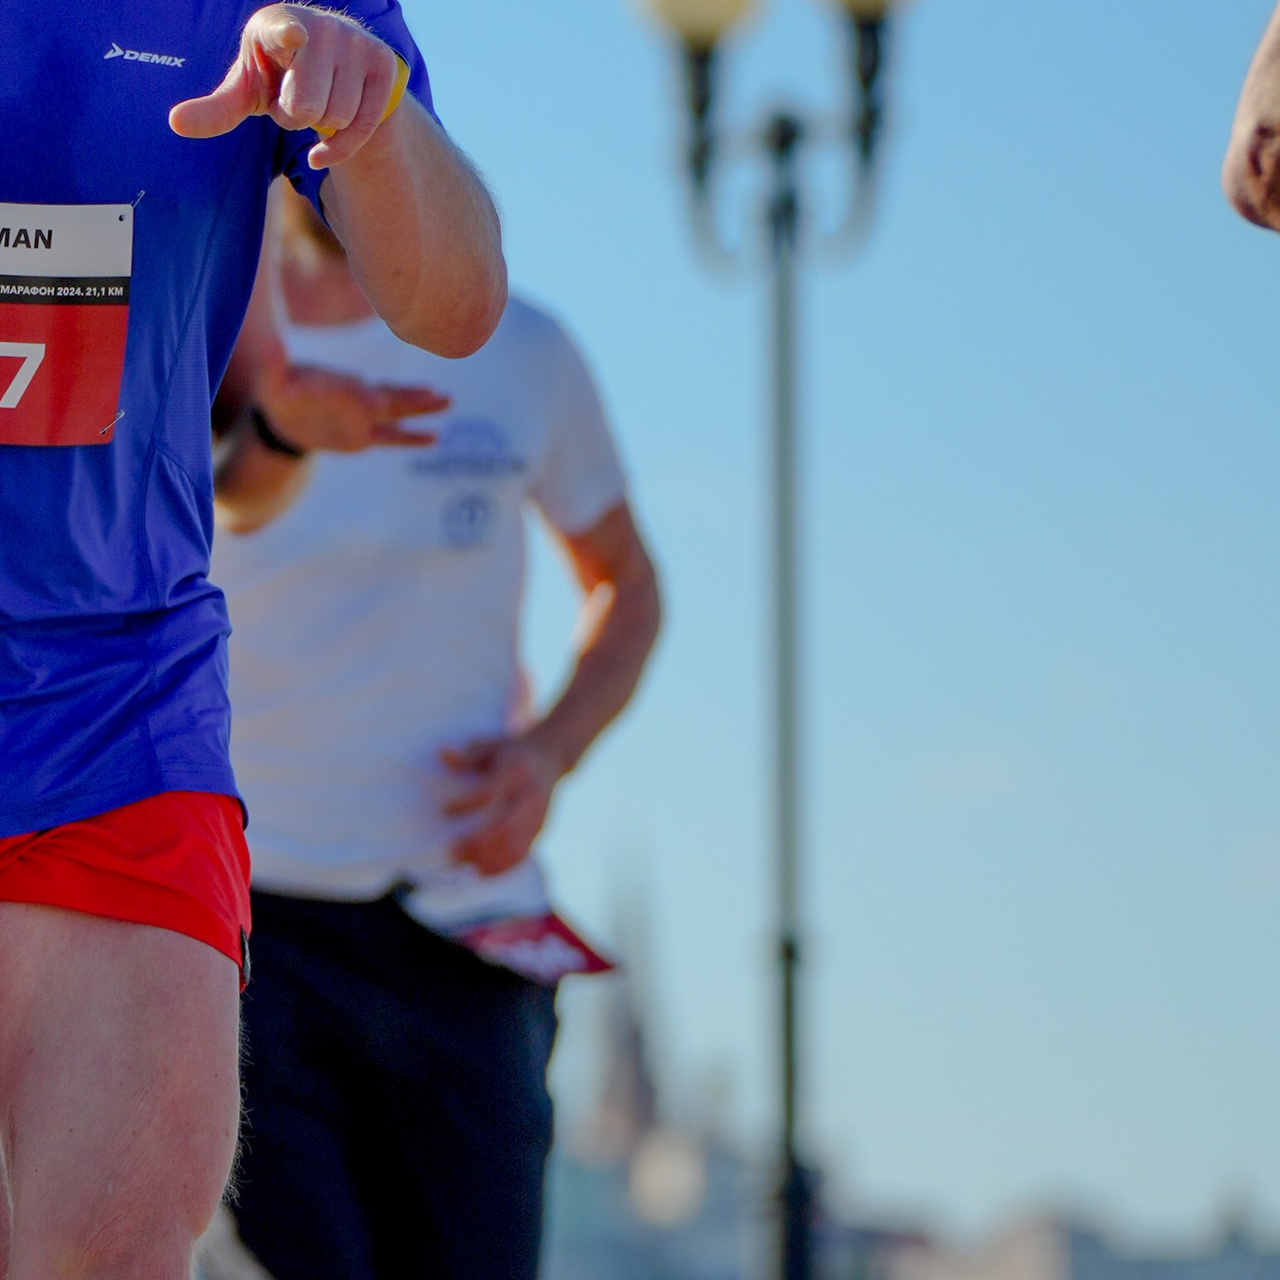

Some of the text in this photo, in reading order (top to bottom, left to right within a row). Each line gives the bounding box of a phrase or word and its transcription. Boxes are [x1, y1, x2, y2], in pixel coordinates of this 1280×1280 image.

[123, 50, 186, 68] DEMIX
[56, 286, 84, 297] 2024.
[85, 286, 106, 298] 21,1
[108, 286, 124, 297] КМ
